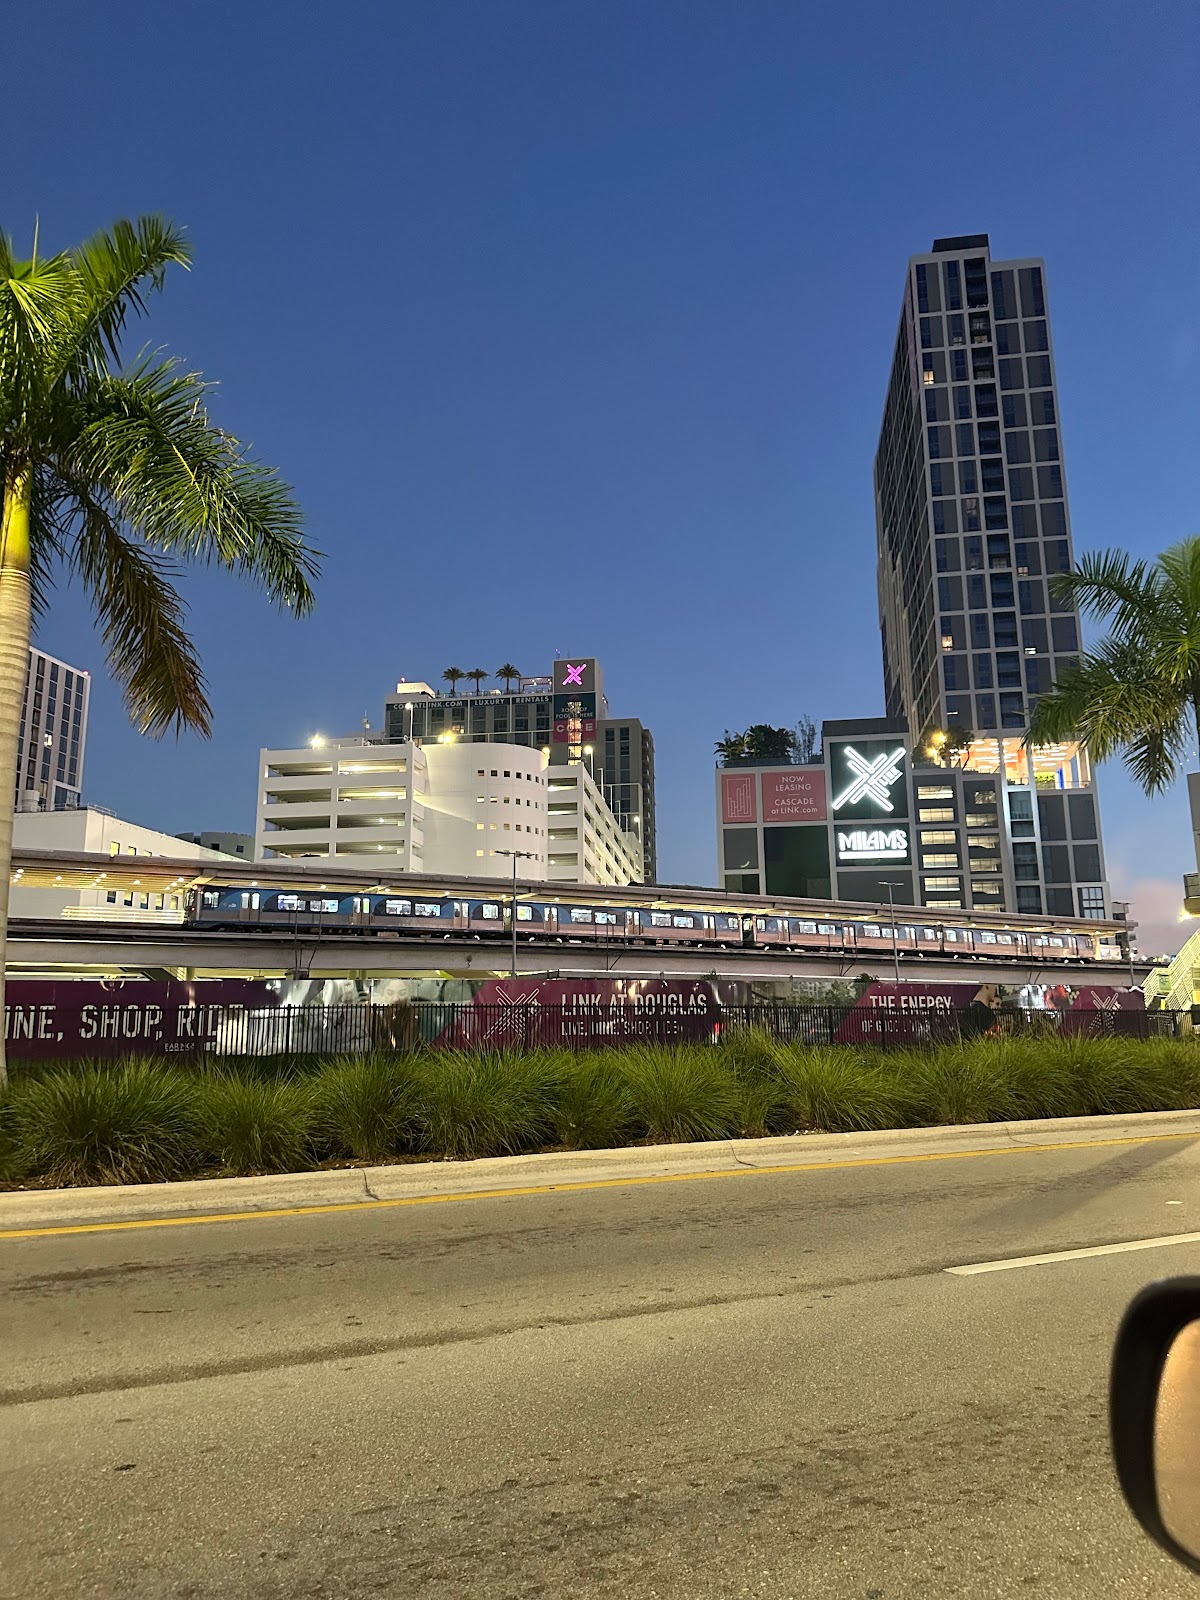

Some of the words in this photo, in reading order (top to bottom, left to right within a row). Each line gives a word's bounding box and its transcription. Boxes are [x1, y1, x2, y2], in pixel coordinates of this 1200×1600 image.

[393, 701, 463, 710] COATLINK.COM
[474, 698, 505, 706] LUXURY
[515, 695, 549, 704] RENTALS
[781, 775, 805, 783] NOW
[775, 783, 812, 792] LEASING
[774, 798, 814, 806] CASCADE
[561, 994, 602, 1016] LINK
[609, 993, 627, 1016] AT
[634, 993, 707, 1016] DOUGLAS
[869, 995, 896, 1015] THE
[900, 996, 952, 1015] ENERGY
[79, 1004, 164, 1041] SHOP,
